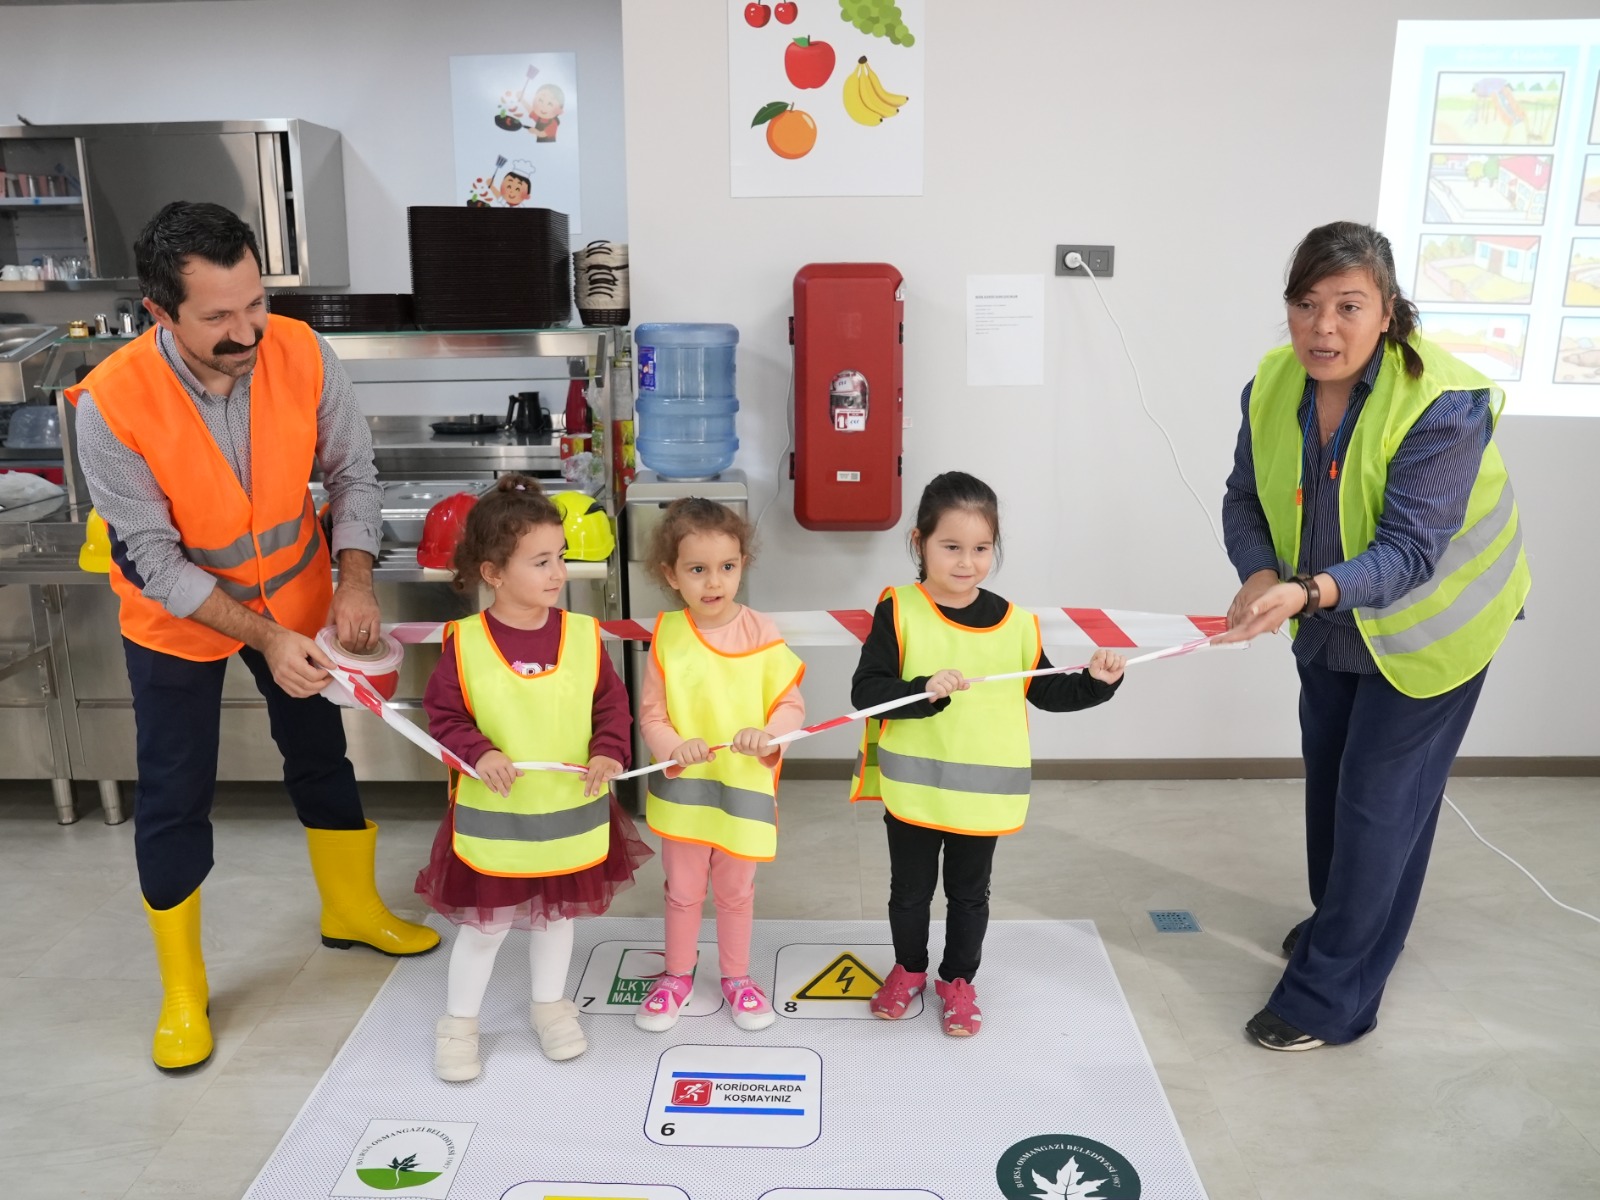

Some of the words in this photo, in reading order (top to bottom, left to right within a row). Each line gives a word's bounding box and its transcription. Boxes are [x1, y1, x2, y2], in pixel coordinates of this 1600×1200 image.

[616, 980, 637, 991] İLK
[582, 997, 596, 1008] 7
[784, 1001, 798, 1013] 8
[715, 1082, 802, 1092] KORİDORLARDA
[724, 1094, 792, 1103] KOŞMAYINIZ
[660, 1122, 676, 1137] 6
[371, 1126, 426, 1146] OSMANGAZİ
[1016, 1143, 1064, 1166] OSMANGAZİ
[1013, 1166, 1025, 1188] BURSA
